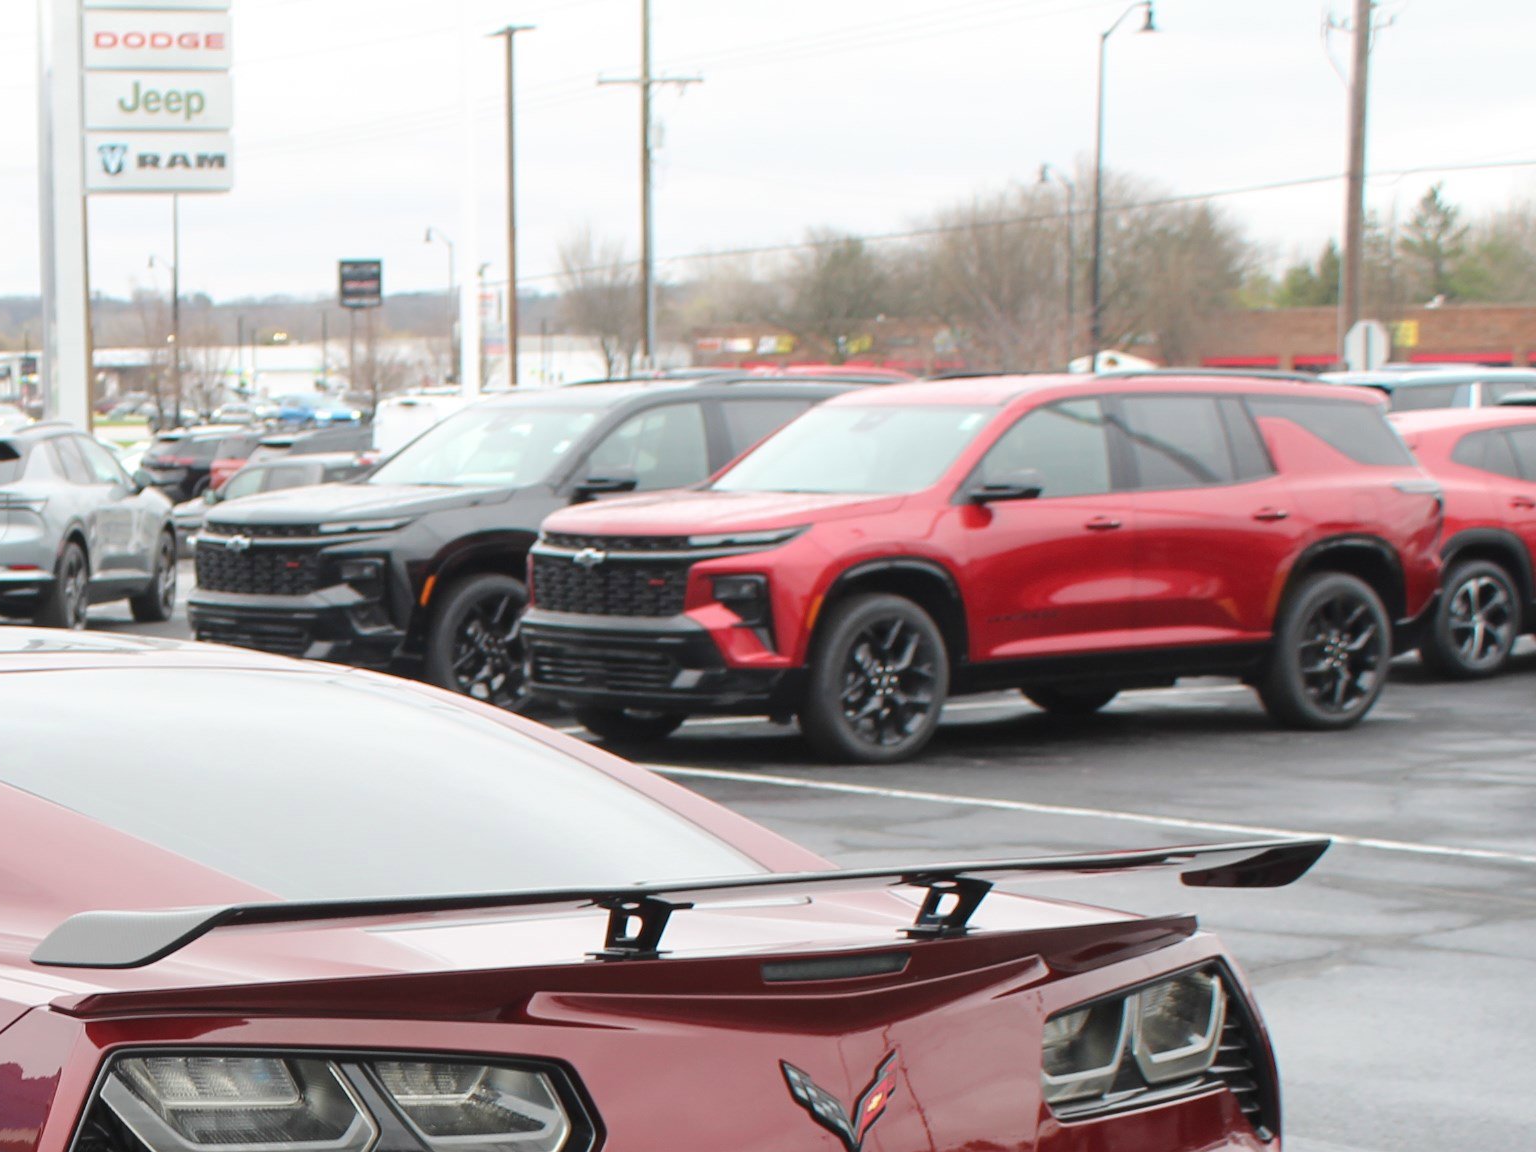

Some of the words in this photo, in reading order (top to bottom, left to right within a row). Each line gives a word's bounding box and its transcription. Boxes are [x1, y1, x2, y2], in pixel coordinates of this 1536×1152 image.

[94, 32, 225, 49] DODGE
[118, 80, 206, 121] Jeep
[136, 152, 227, 169] RAM
